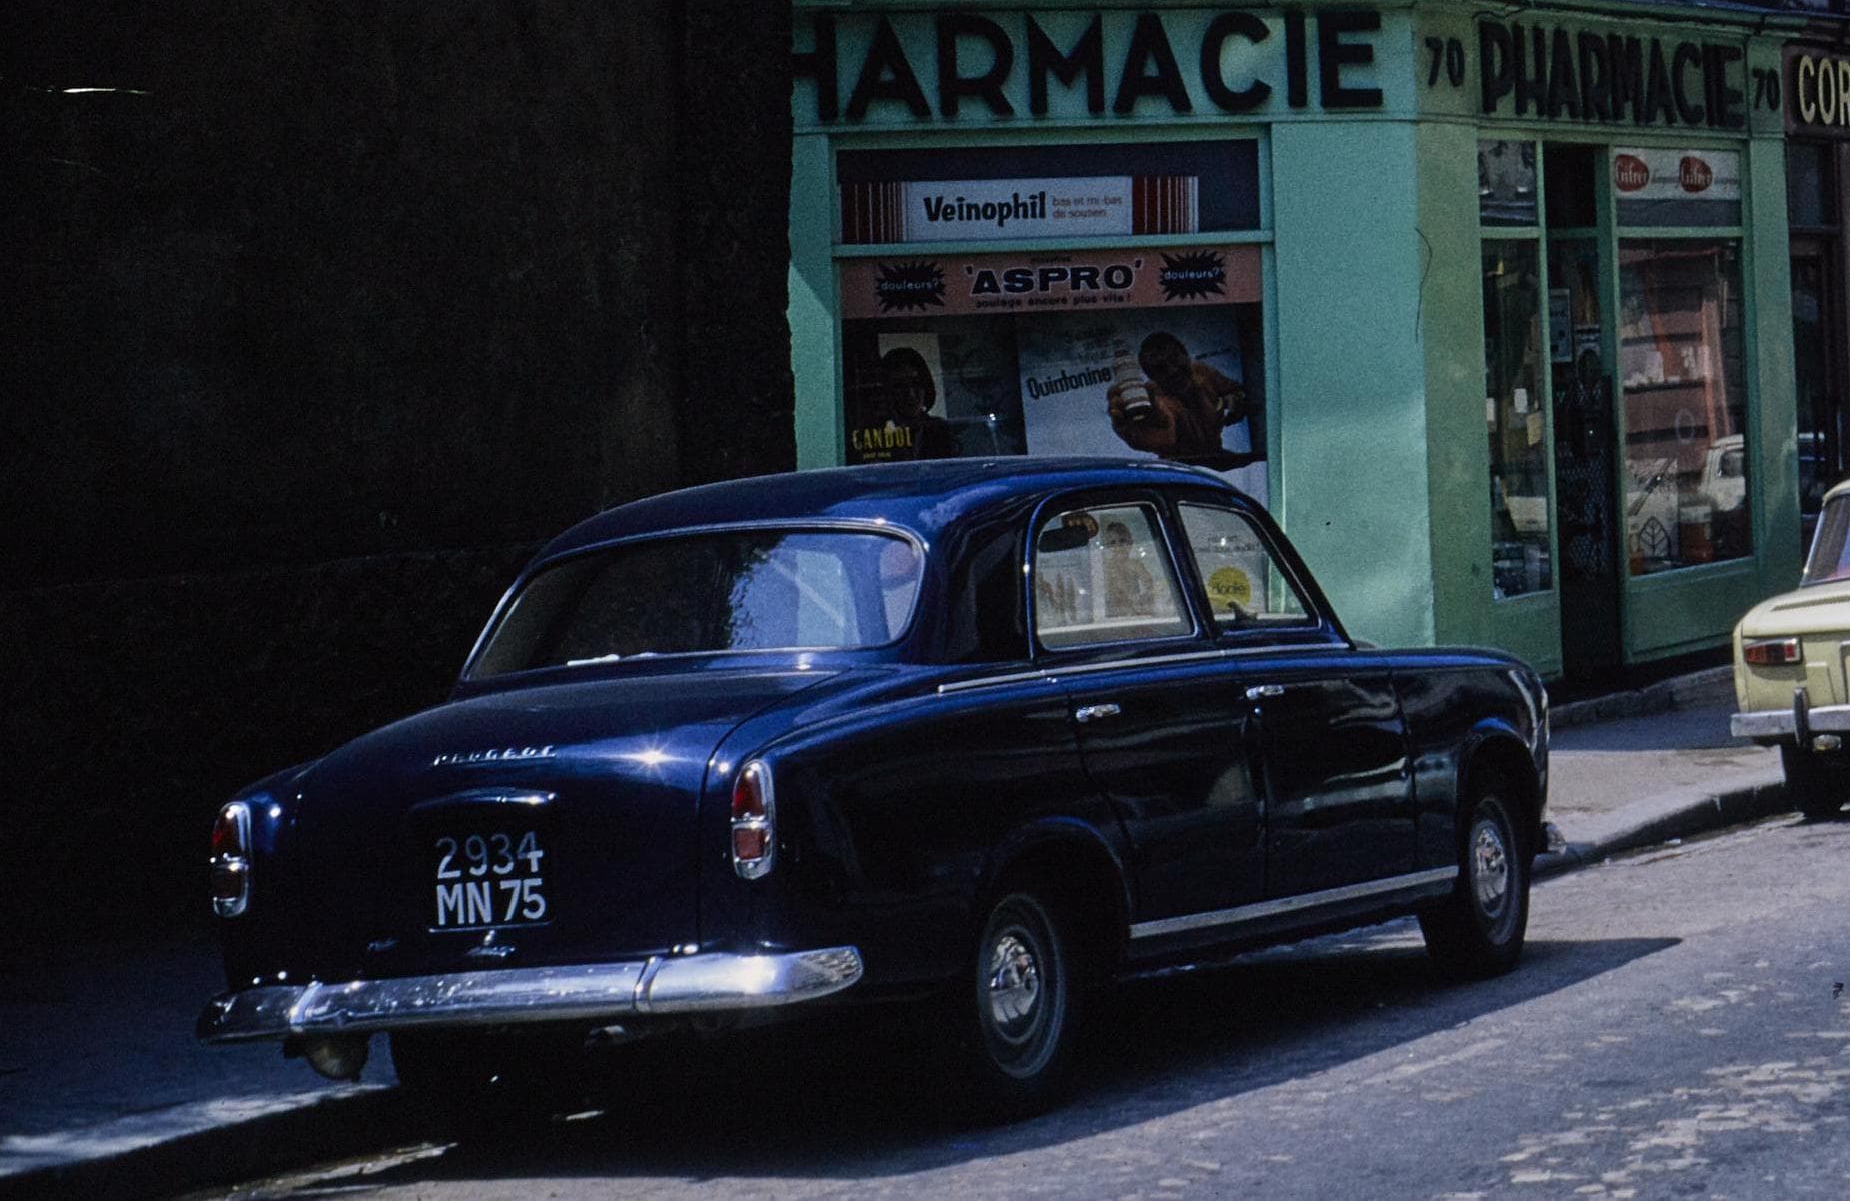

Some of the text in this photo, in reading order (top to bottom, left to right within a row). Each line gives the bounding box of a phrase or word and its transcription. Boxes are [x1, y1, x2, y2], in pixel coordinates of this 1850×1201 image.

[1425, 36, 1463, 88] 70
[1478, 19, 1747, 129] PHARMACIE
[1752, 67, 1780, 111] 70
[923, 192, 1046, 227] Veinophil
[1027, 367, 1112, 400] Quintonine
[436, 830, 544, 880] 2934
[436, 877, 548, 926] MN 75
